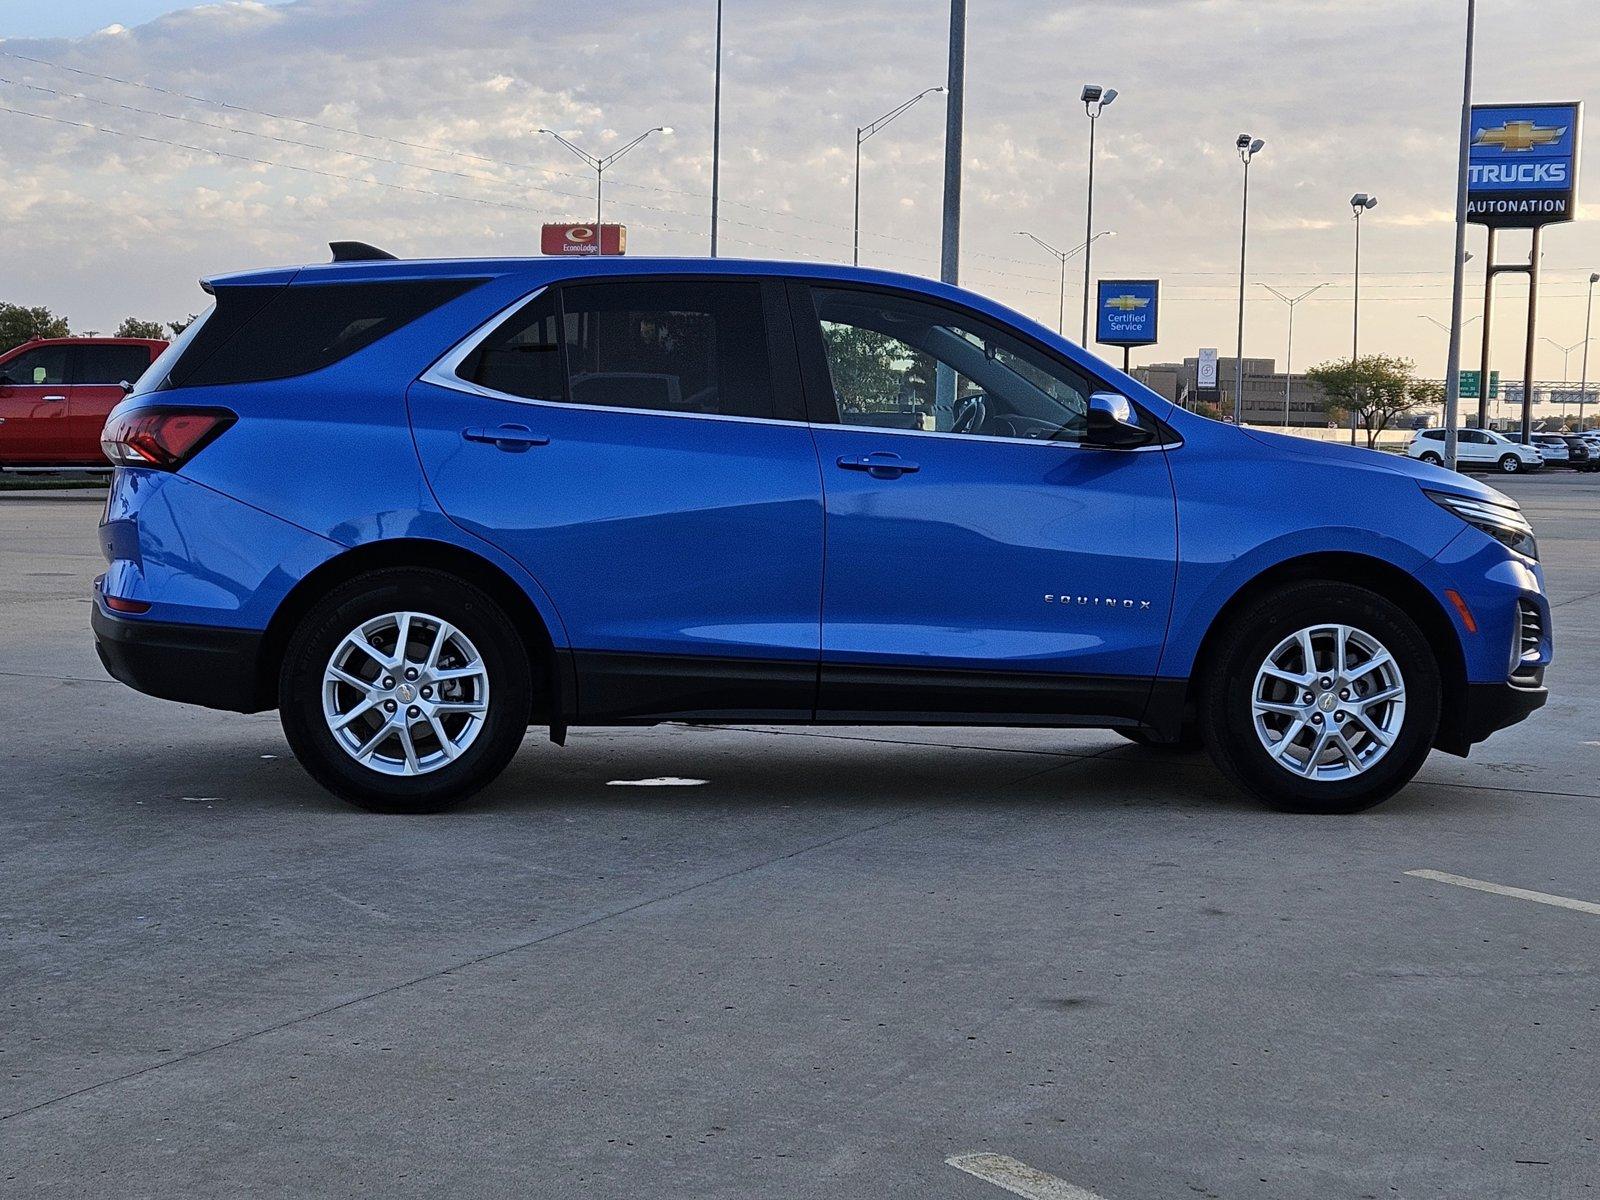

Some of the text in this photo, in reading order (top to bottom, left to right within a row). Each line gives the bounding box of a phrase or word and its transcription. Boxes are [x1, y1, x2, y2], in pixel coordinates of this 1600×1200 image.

[1468, 163, 1566, 183] TRUCKS
[1467, 199, 1566, 213] AUTONATION
[1108, 313, 1146, 322] Certified
[1110, 322, 1143, 331] Service
[1044, 594, 1151, 610] EQUINOX
